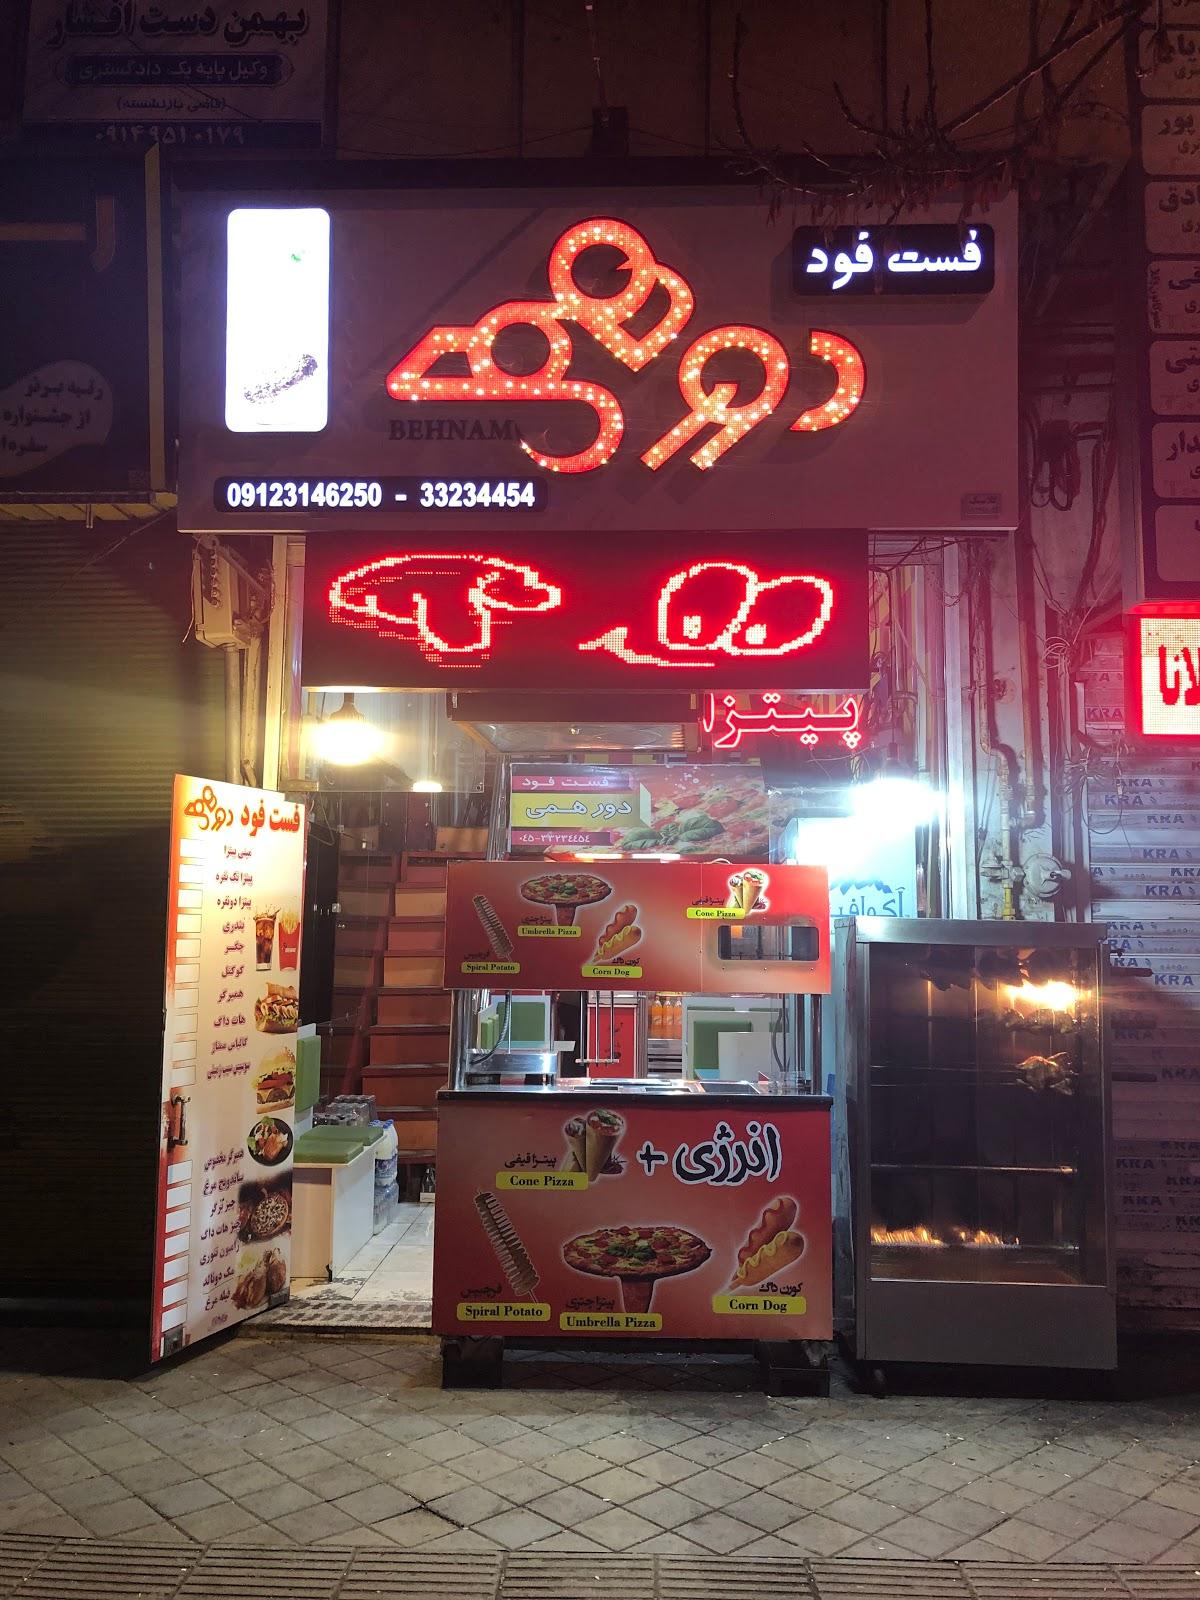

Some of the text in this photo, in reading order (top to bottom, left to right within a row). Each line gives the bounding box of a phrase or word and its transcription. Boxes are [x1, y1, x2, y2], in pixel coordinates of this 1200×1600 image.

[140, 5, 217, 35] دست
[224, 7, 307, 47] بهمن
[196, 63, 226, 82] پایه
[229, 61, 269, 81] وکیل
[806, 229, 982, 290] فست فود
[226, 481, 383, 508] 09123146250
[419, 481, 536, 508] 33234454
[702, 692, 862, 750] پیتزا
[1086, 707, 1123, 720] KRA
[521, 776, 609, 790] فست فود
[526, 800, 632, 820] دور همی
[240, 799, 265, 837] فود
[269, 804, 301, 833] فست
[1142, 848, 1180, 859] KRA
[1145, 885, 1182, 896] KRA
[695, 909, 715, 917] Cone
[466, 963, 515, 973] Spiral Potato
[592, 967, 630, 977] Corn Dog
[1154, 974, 1194, 986] KRA
[504, 1152, 557, 1168] پیتزا قیفی
[673, 1121, 782, 1186] انرژی
[509, 1175, 574, 1187] Cone Pizza
[465, 1305, 544, 1318] Spiral Potato
[729, 1299, 788, 1313] Corn Dog
[566, 1316, 656, 1328] Umbrella Pizza
